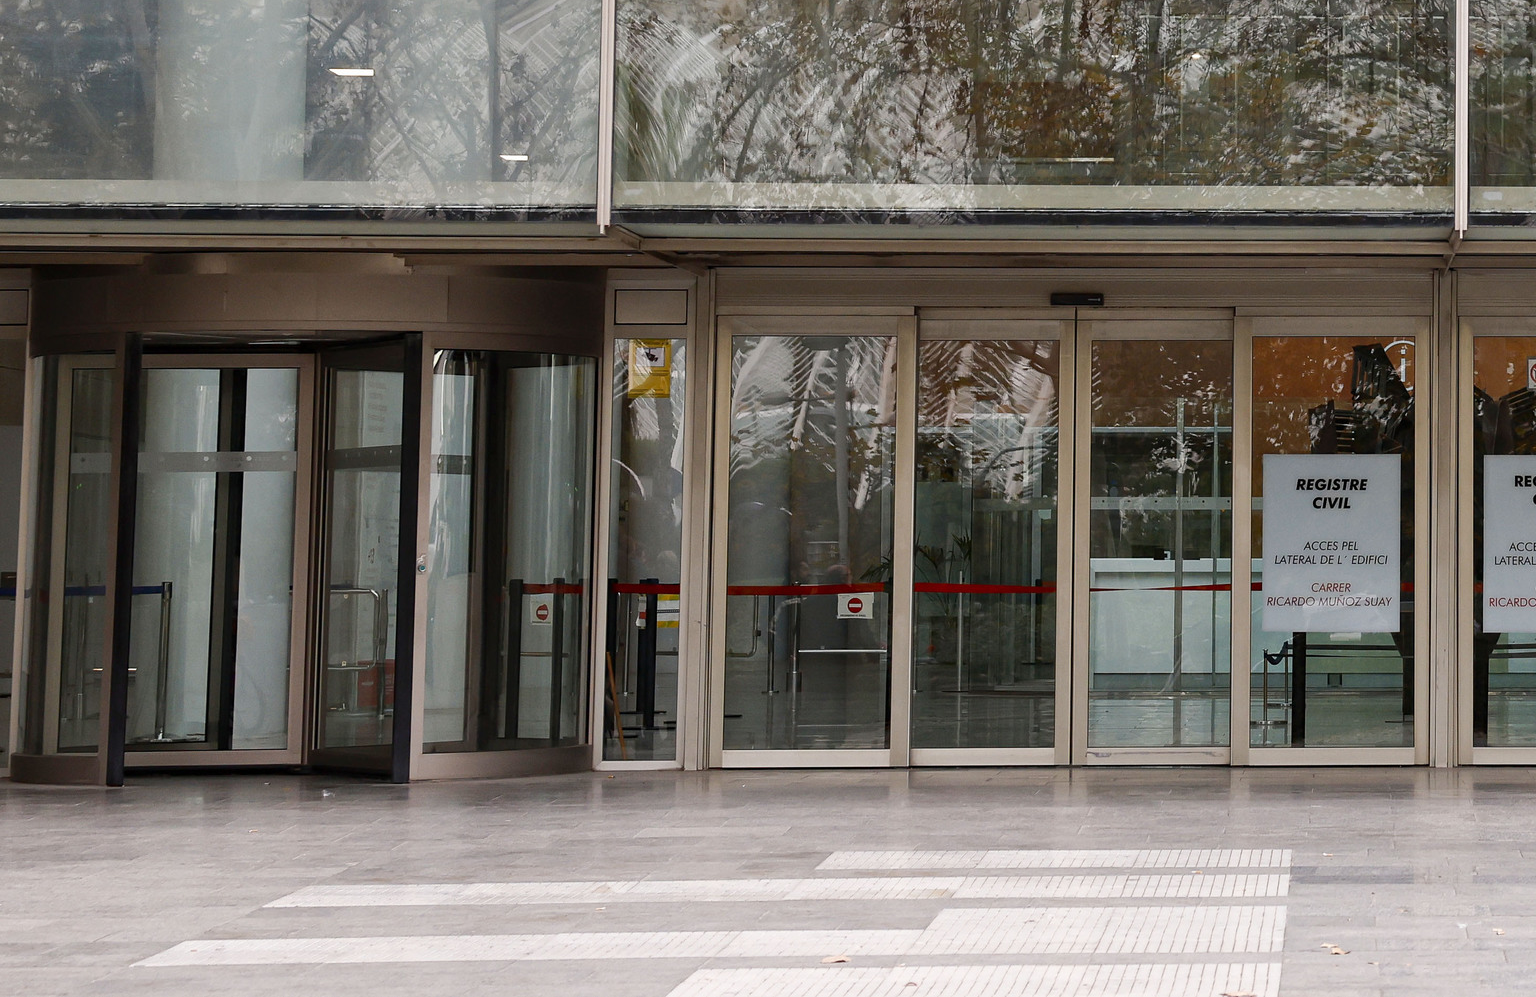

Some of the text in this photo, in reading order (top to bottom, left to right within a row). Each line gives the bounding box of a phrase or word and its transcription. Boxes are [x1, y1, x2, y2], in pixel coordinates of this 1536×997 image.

[1296, 478, 1368, 491] REGISTRE
[1312, 497, 1351, 509] CIVIL
[1303, 541, 1359, 551] ACCES PEL
[1274, 555, 1317, 565] LATERAL
[1320, 555, 1334, 565] DE
[1351, 555, 1388, 565] EDIFICI
[1494, 556, 1536, 566] LATERAL
[1311, 582, 1351, 593] CARRER
[1266, 594, 1393, 607] RICARDO MUÑOZ SUAY
